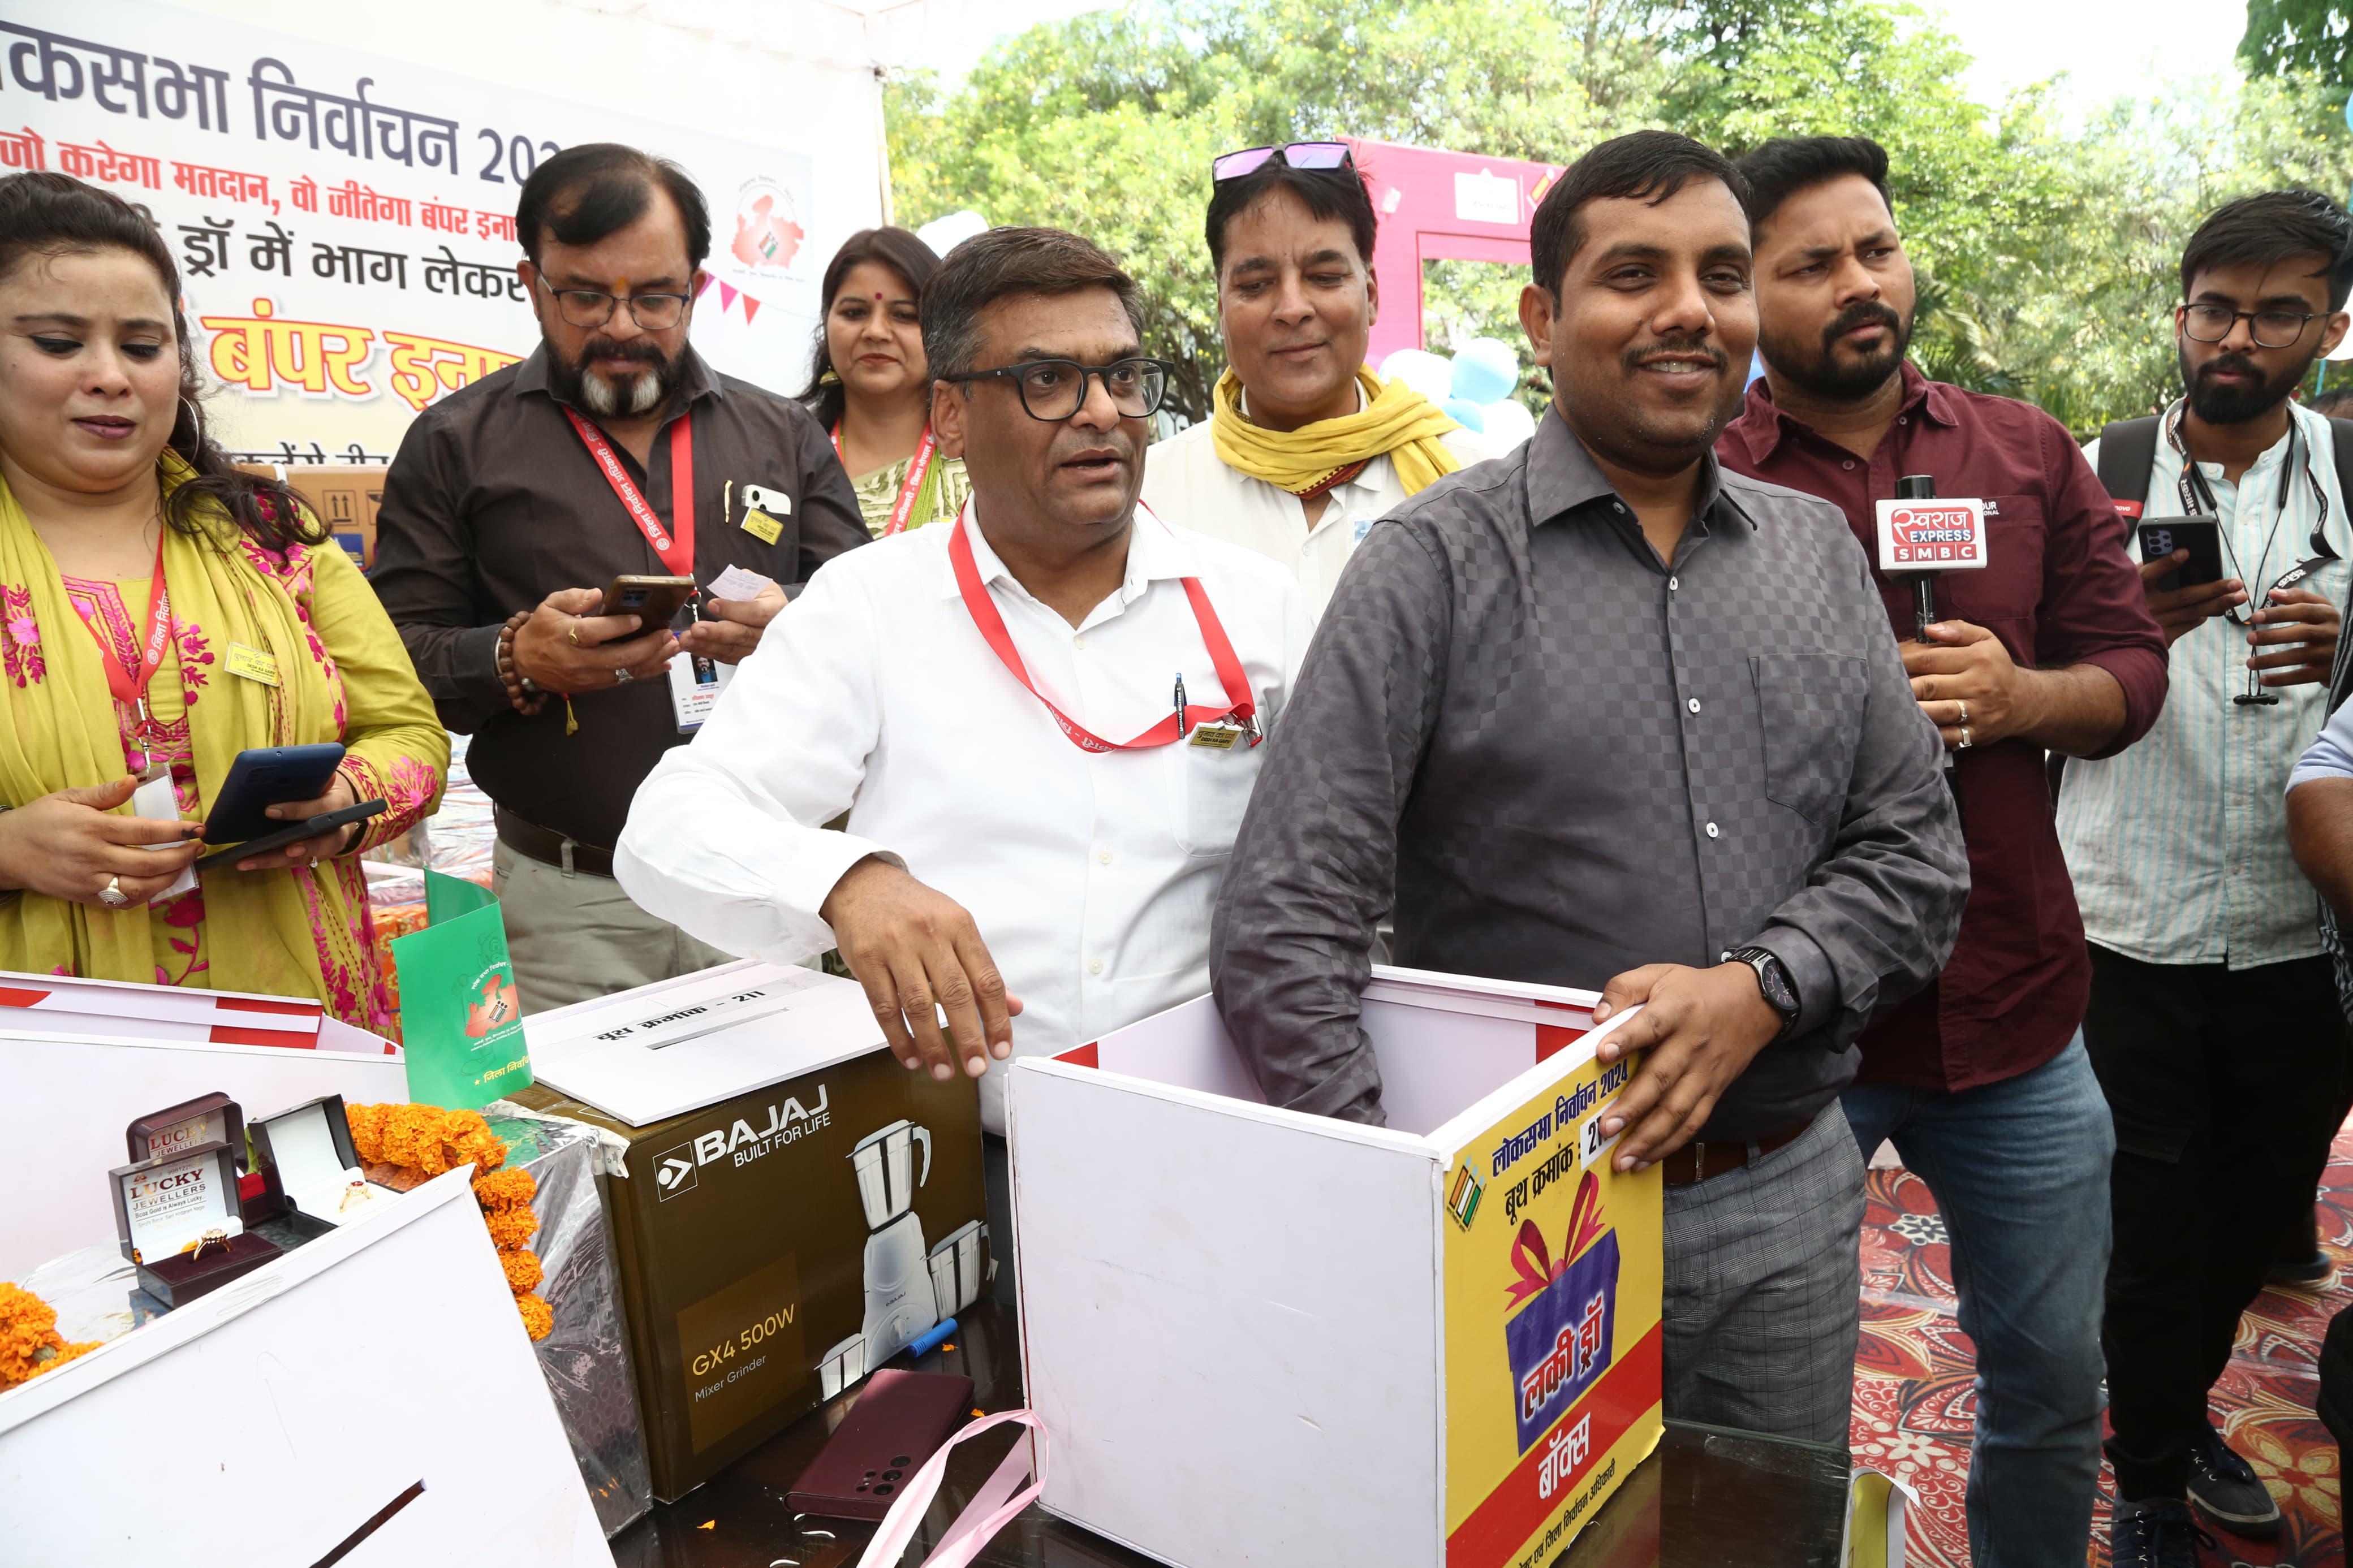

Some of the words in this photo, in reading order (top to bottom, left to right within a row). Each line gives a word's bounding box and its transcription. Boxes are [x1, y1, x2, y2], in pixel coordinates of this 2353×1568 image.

[0, 20, 229, 134] कसभा
[248, 57, 459, 175] निर्वाचन
[478, 128, 561, 187] 20
[0, 127, 45, 171] जो
[57, 139, 162, 190] करेगा
[171, 159, 281, 215] मतदान,
[289, 174, 318, 213] वो
[327, 180, 412, 227] जीतेगा
[419, 196, 469, 235] बंपर
[475, 210, 517, 241] इना
[178, 216, 234, 278] ड्रॉ
[247, 221, 294, 277] में
[312, 242, 408, 290] भाग
[421, 245, 526, 302] लेकर
[200, 298, 375, 395] बंपर
[597, 447, 625, 483] अधिकारी
[621, 482, 645, 515] निर्वाचन
[641, 513, 662, 538] जिला
[1893, 508, 1969, 543] स्वराज
[1910, 529, 1972, 543] EXPRESS
[151, 621, 167, 650] जिला
[637, 1006, 709, 1029] क्रमांक
[731, 991, 766, 1002] 211
[483, 1067, 506, 1083] जिला
[149, 1121, 209, 1150] LUCKY
[693, 1083, 828, 1167] BAJAJ
[1492, 1111, 1552, 1178] लोकसभा
[1554, 1079, 1598, 1131] निर्वाचन
[1600, 1058, 1628, 1099] 2024
[156, 1137, 205, 1157] JEWELLERS
[734, 1138, 771, 1168] BUILT
[774, 1126, 802, 1149] FOR
[804, 1112, 831, 1135] LIFE
[131, 1168, 204, 1199] LUCKY
[133, 1183, 206, 1211] JEWELLERS
[169, 1199, 186, 1208] Always
[1504, 1176, 1529, 1226] बूथ
[1532, 1141, 1574, 1199] क्रमांक
[692, 1340, 735, 1376] GX4
[740, 1303, 794, 1350] 500W
[695, 1379, 725, 1403] Mixer
[727, 1355, 766, 1383] Grinder
[1522, 1327, 1575, 1420] लकी
[1537, 1411, 1591, 1500] बॉक्स
[1533, 1538, 1545, 1564] एवं
[1545, 1530, 1563, 1552] जिला
[1563, 1492, 1589, 1532] निर्वाचन
[1590, 1457, 1616, 1501] अधिकारी
